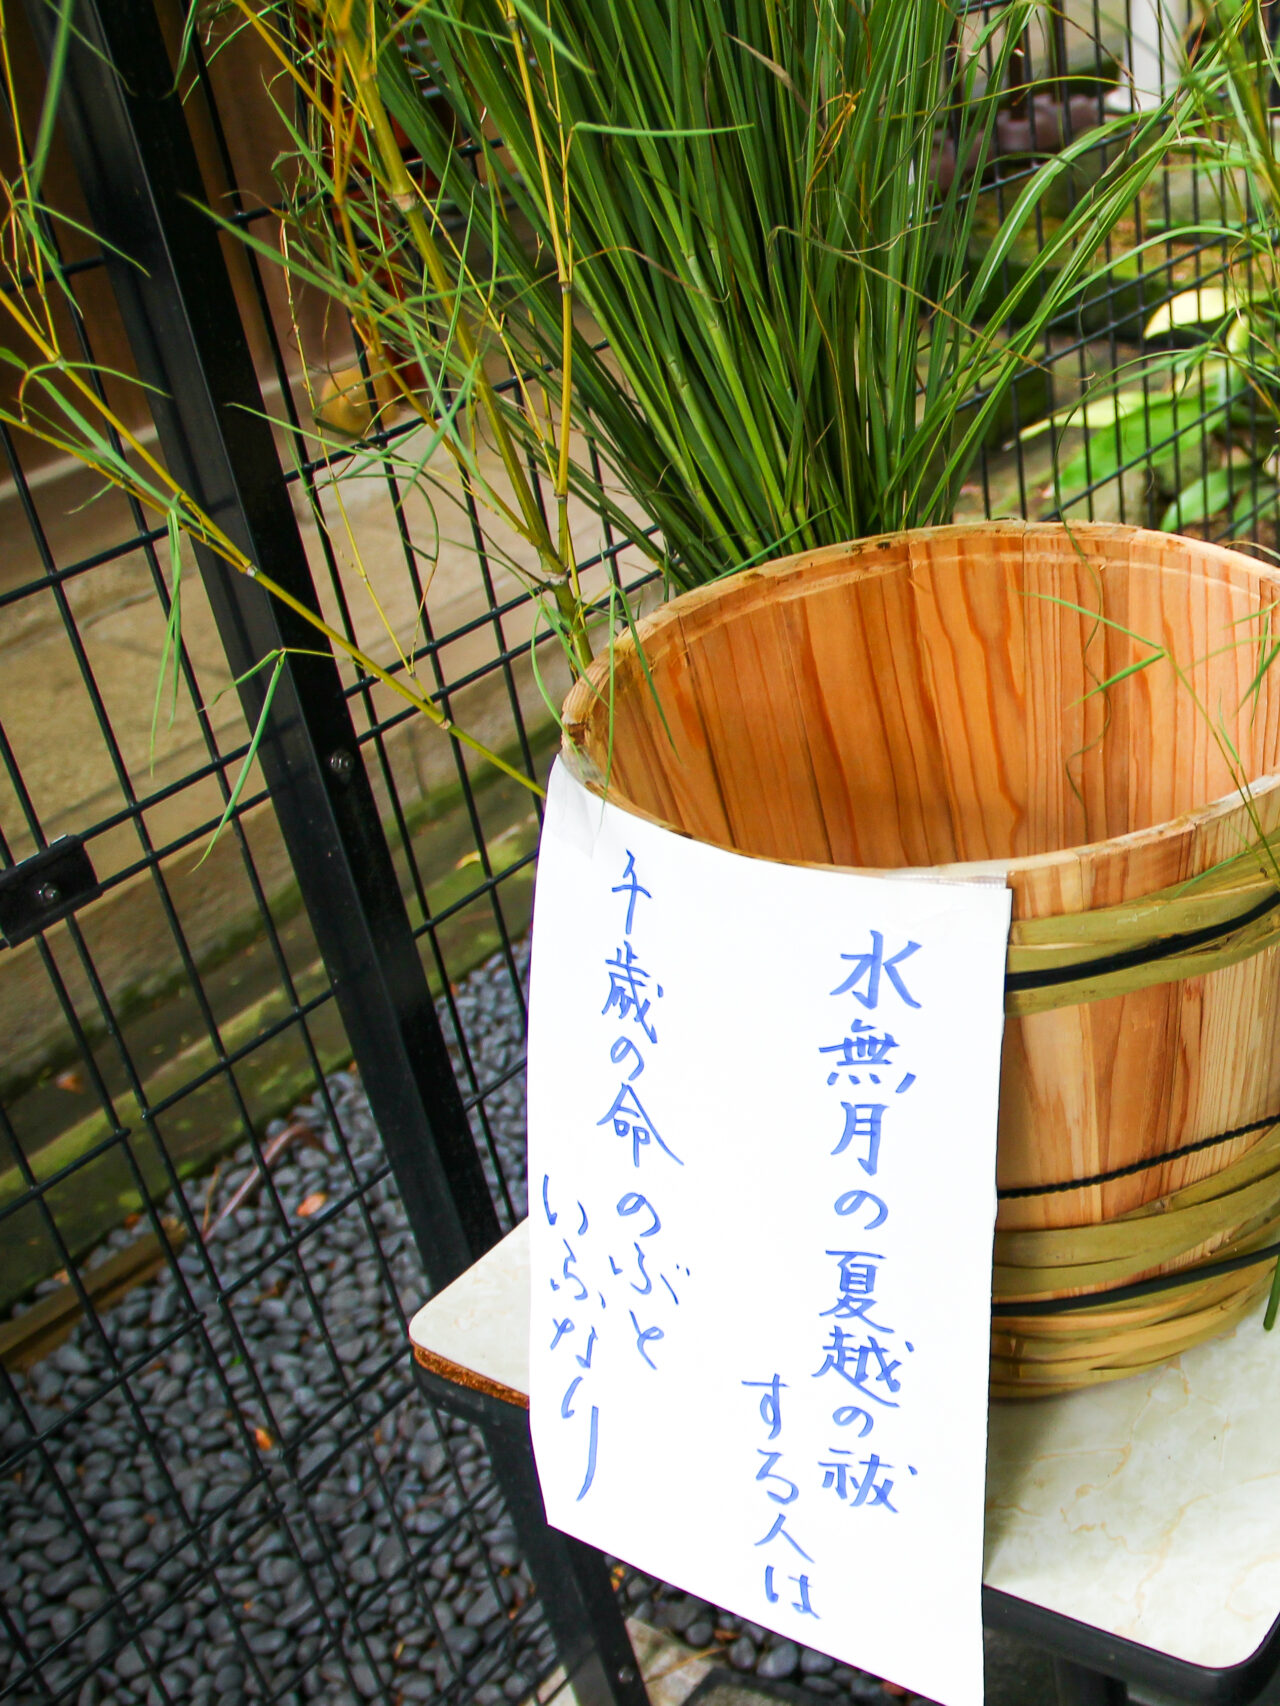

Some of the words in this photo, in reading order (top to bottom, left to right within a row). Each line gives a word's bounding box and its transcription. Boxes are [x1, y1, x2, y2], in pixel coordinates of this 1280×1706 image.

[811, 929, 922, 1514] 水無月の夏越の祓
[741, 1373, 822, 1620] する人は
